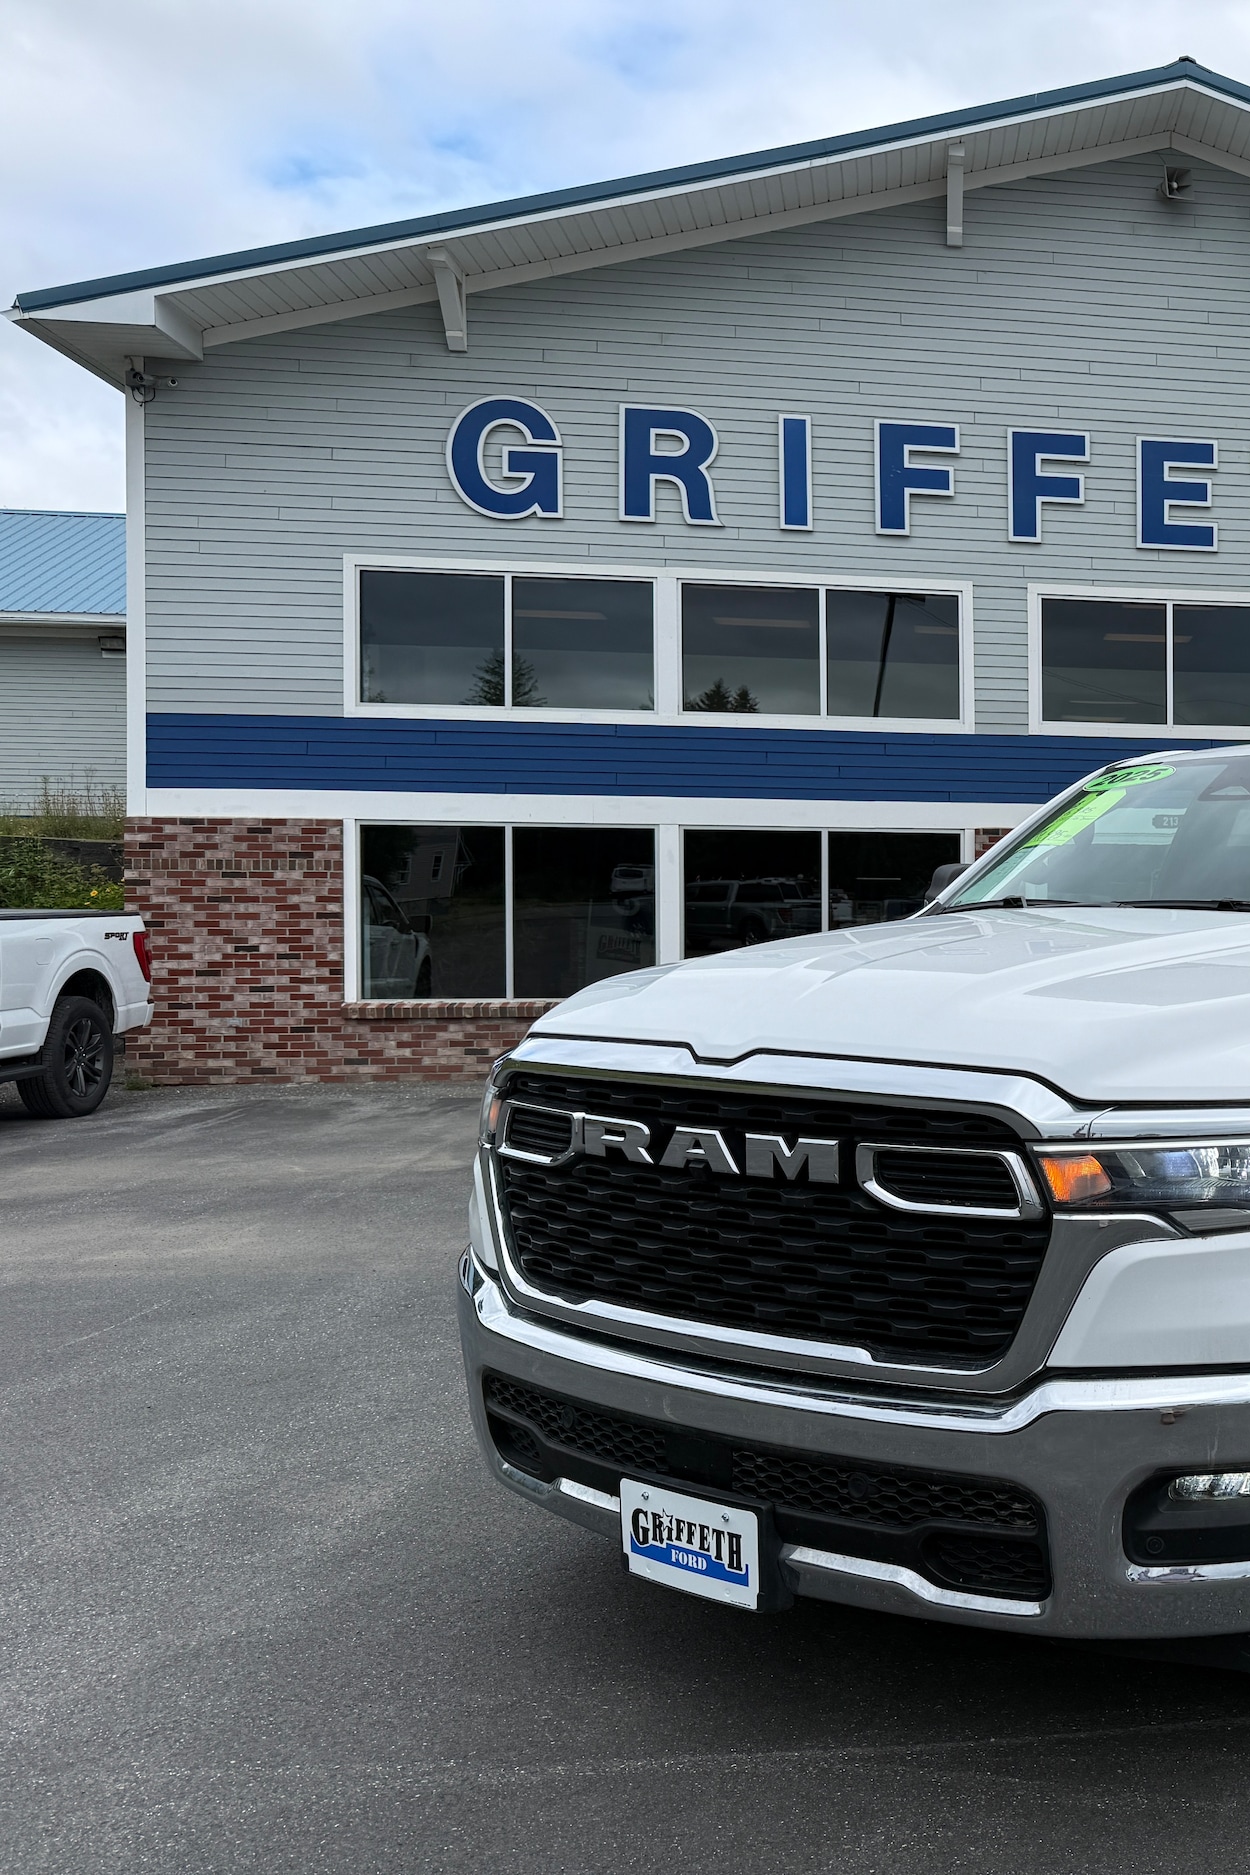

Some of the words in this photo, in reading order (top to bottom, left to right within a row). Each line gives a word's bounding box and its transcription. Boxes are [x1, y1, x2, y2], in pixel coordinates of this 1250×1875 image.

[1089, 768, 1169, 789] 2025
[1162, 816, 1179, 827] 213
[104, 932, 130, 940] SPORT
[583, 1113, 839, 1185] RAM
[671, 1548, 708, 1571] FORD
